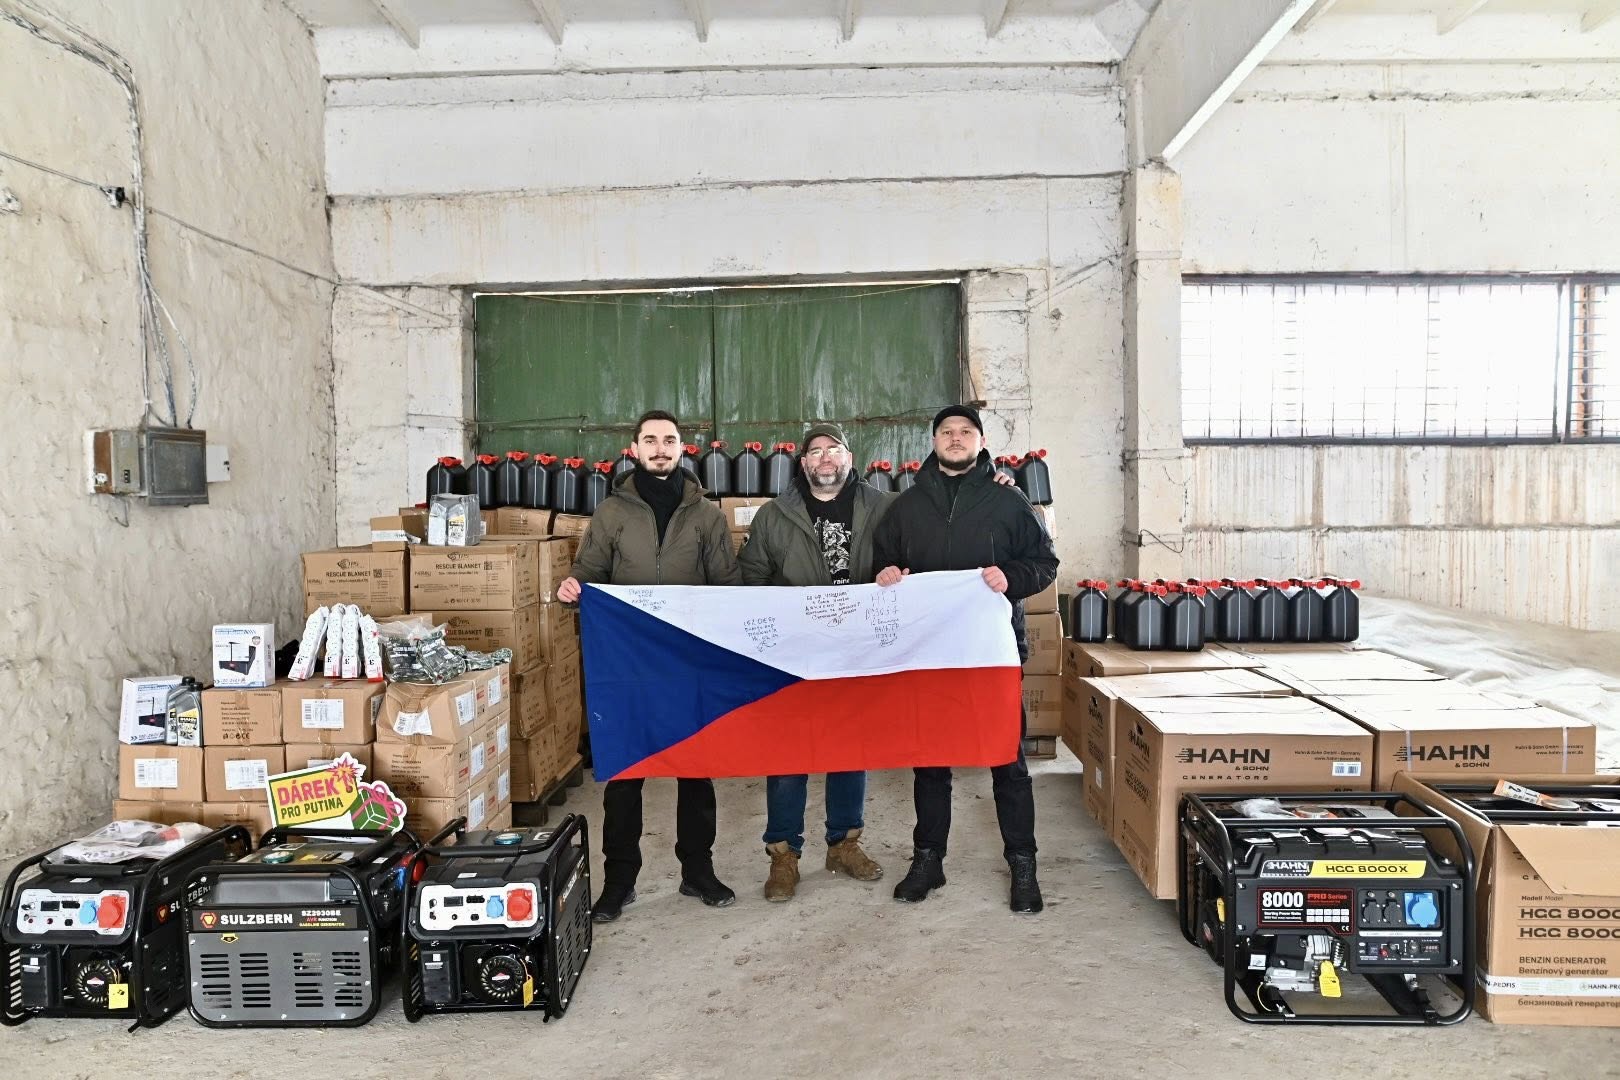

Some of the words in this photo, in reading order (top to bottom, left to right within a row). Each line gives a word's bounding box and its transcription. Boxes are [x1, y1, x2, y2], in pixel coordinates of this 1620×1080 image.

[1183, 748, 1270, 763] HAHN
[1401, 745, 1490, 761] HAHN
[277, 778, 339, 806] DÁREK
[281, 804, 301, 819] PRO
[304, 797, 344, 815] PUTINA
[1270, 861, 1307, 870] HAHN
[1358, 865, 1408, 873] 8000X
[1262, 891, 1304, 908] 8000
[220, 913, 293, 925] SULZBERN
[1520, 956, 1550, 964] BENZIN
[1553, 957, 1606, 965] GENERATOR
[1566, 968, 1608, 976] generátor
[1518, 998, 1572, 1007] бензиновый
